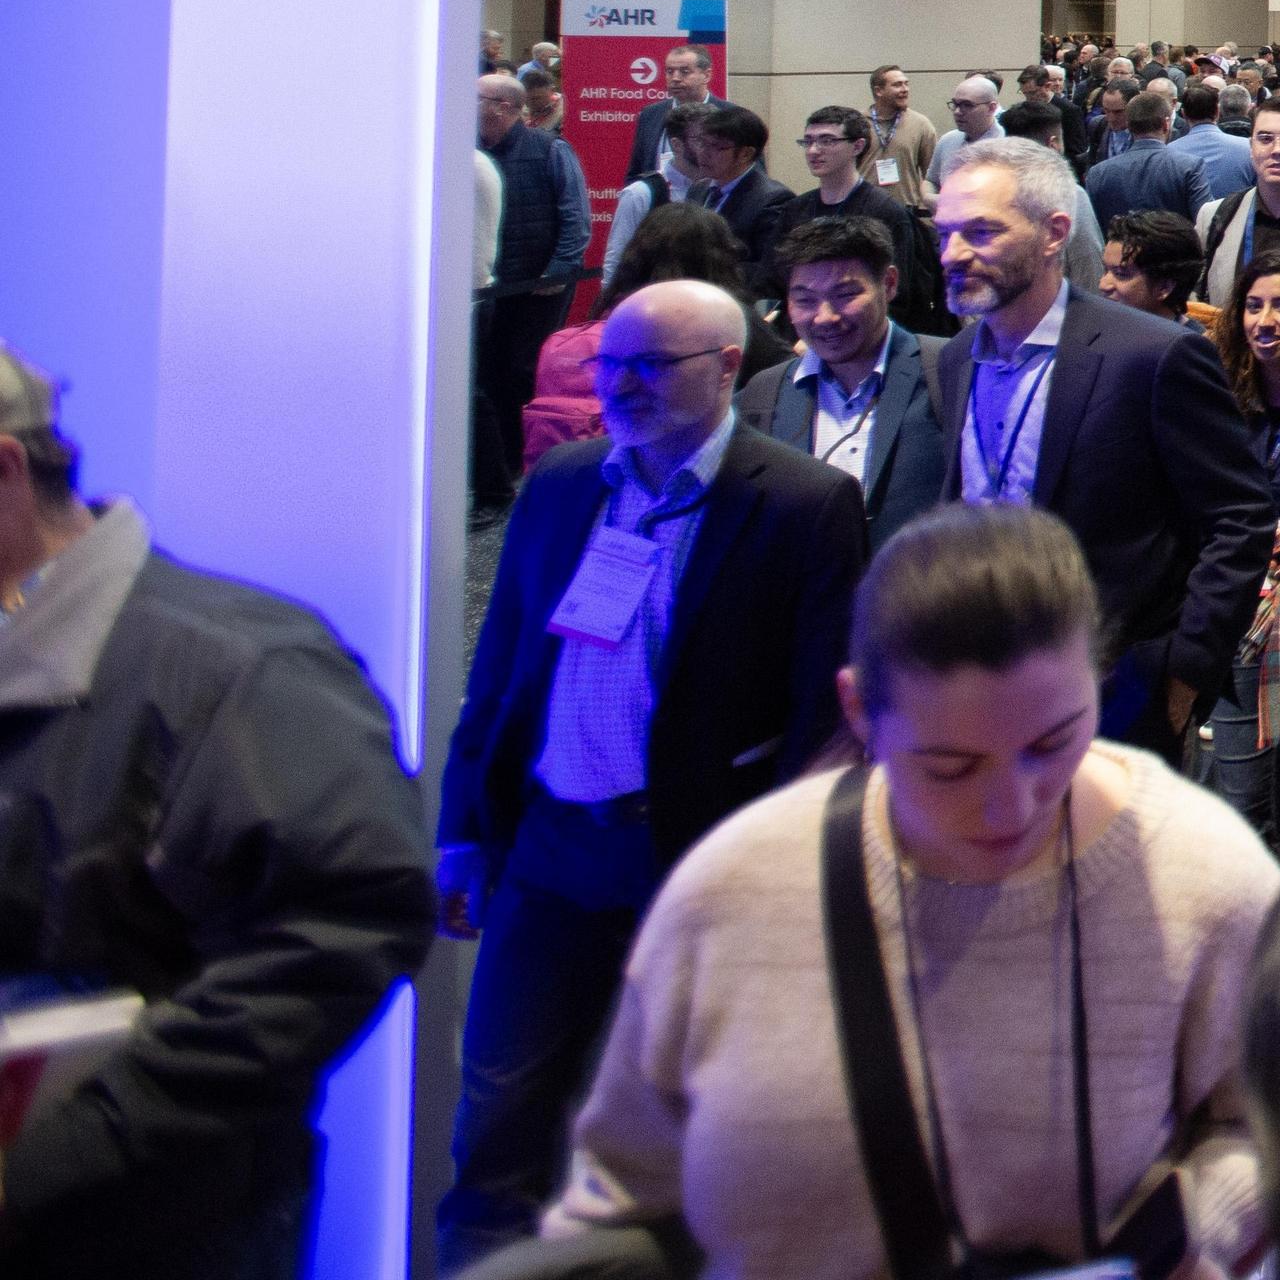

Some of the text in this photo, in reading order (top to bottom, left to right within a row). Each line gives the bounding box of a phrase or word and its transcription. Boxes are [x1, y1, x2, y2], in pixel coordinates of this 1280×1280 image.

[607, 8, 657, 26] AHR
[580, 88, 608, 99] AHR
[610, 88, 643, 99] Food
[580, 111, 635, 122] Exhibitor
[586, 187, 623, 200] huttle
